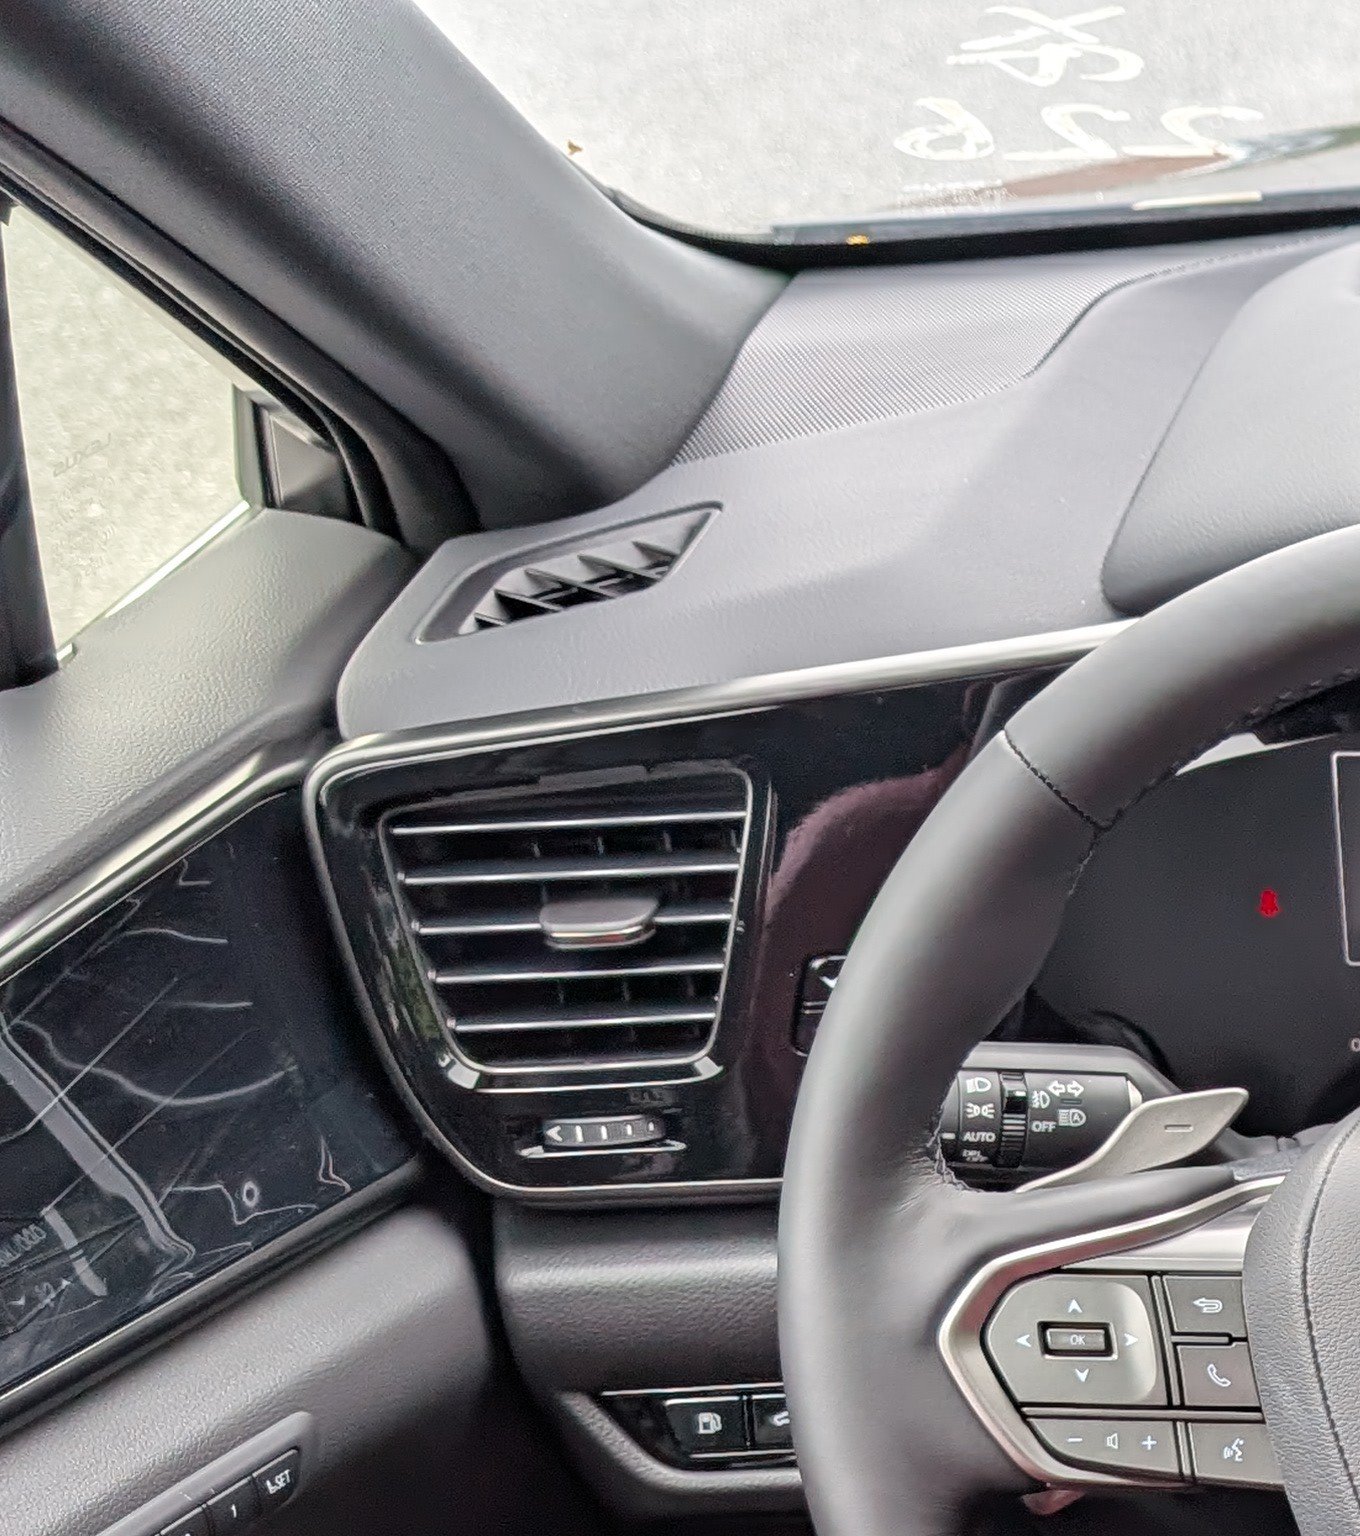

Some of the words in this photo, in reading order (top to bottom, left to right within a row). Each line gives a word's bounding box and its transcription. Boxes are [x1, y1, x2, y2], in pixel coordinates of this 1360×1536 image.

[1031, 1120, 1056, 1133] OFF
[961, 1130, 997, 1143] AUTO
[1069, 1334, 1087, 1347] OK
[230, 1503, 239, 1519] 1
